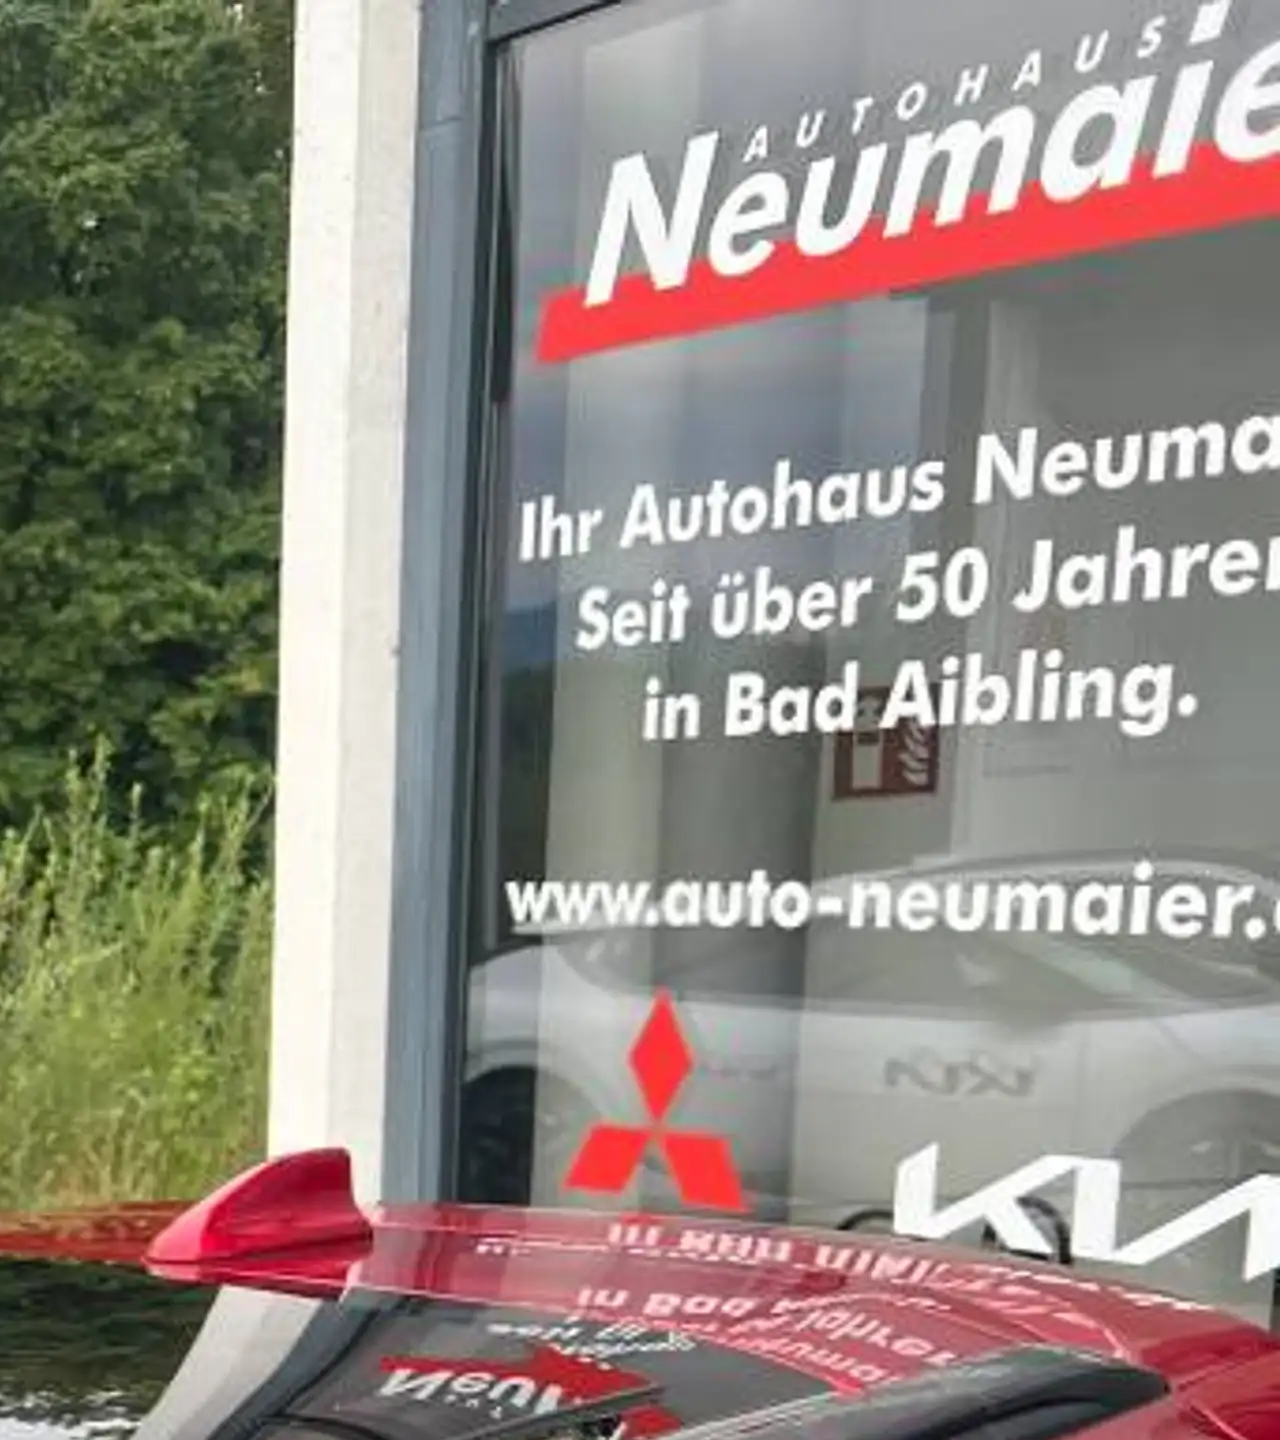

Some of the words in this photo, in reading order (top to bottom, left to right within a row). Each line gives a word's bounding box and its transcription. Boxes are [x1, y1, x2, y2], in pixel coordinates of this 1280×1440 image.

[742, 15, 1167, 162] AUTOHAUS
[519, 495, 604, 562] Ihr
[619, 458, 946, 549] Autohaus
[973, 415, 1280, 505] Neuma
[576, 577, 691, 651] Seit
[711, 566, 873, 640] über
[896, 547, 989, 623] 50
[643, 677, 701, 740] in
[724, 661, 860, 737] Bad
[878, 648, 1198, 737] Aibling.
[505, 860, 1280, 940] www.auto-neumaier.
